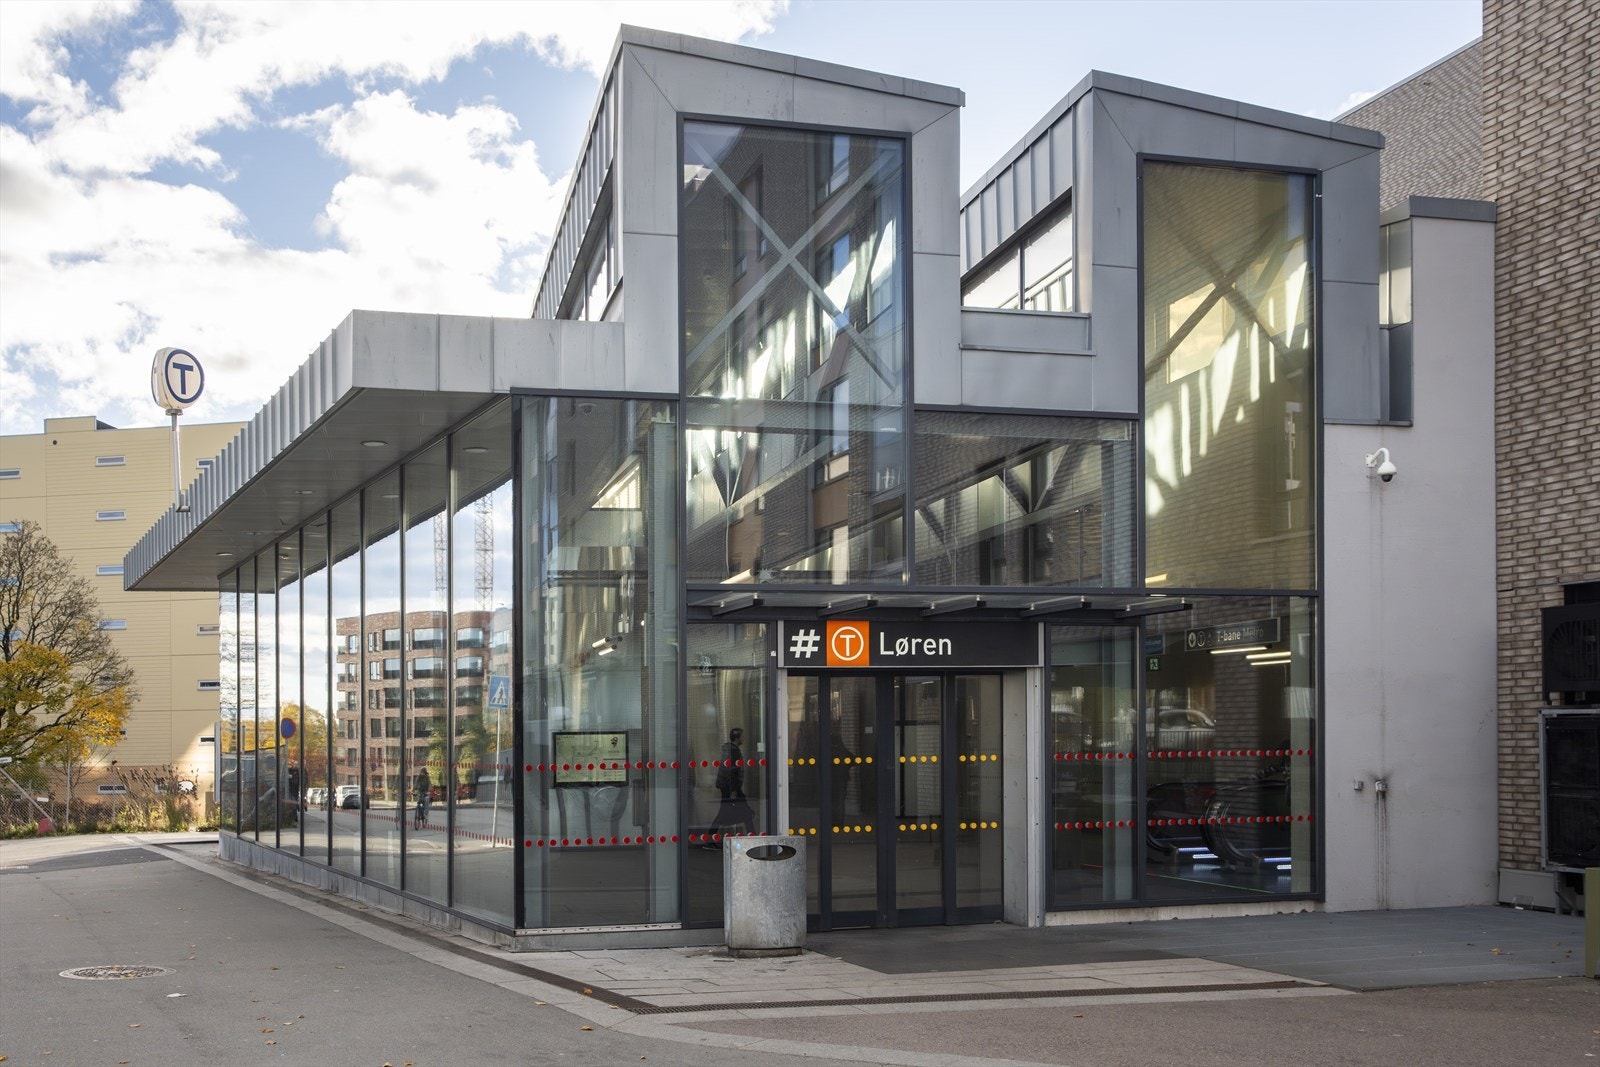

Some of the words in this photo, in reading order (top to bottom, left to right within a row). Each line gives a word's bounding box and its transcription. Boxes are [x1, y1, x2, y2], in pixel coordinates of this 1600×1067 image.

[172, 362, 194, 395] T
[839, 634, 856, 657] T
[879, 631, 952, 657] Løren
[1216, 630, 1241, 642] T-bane
